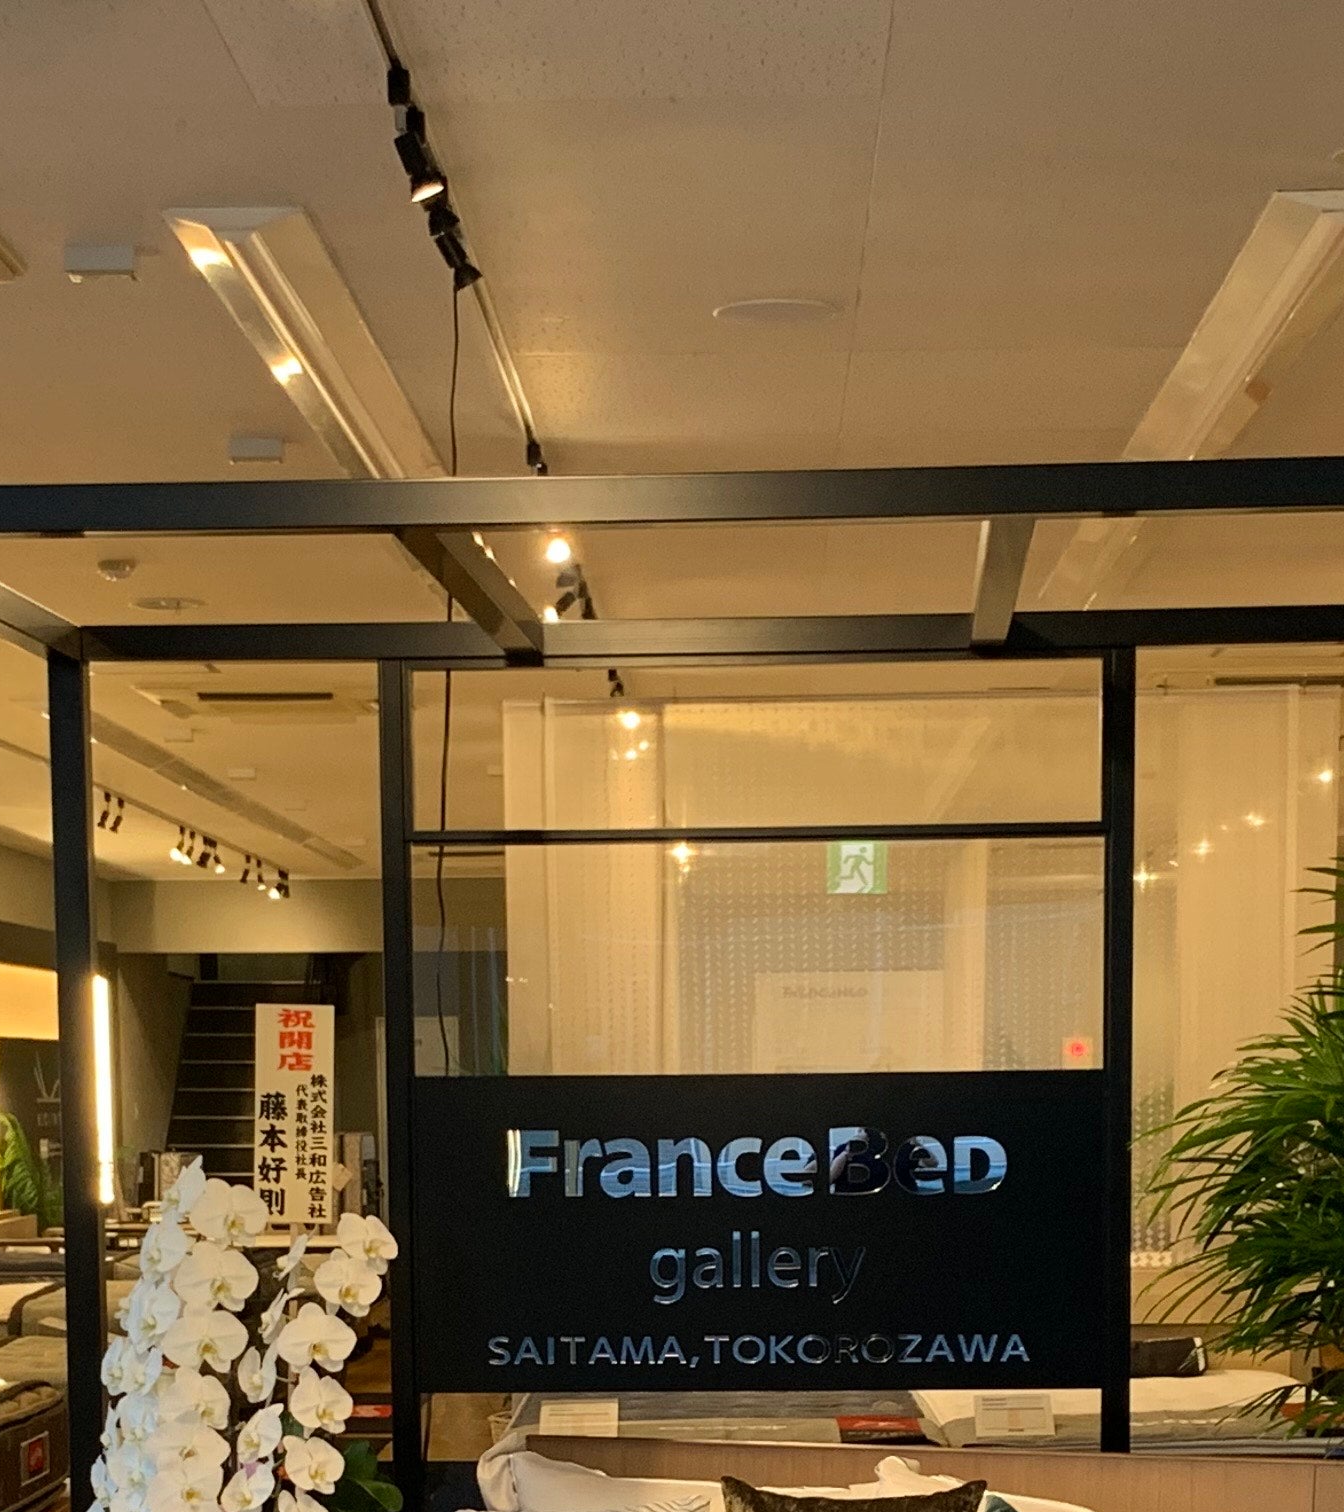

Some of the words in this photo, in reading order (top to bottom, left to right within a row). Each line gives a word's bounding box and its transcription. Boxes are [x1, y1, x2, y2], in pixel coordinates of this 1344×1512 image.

[277, 1008, 316, 1071] 祝開店
[258, 1091, 288, 1216] 藤本好則
[309, 1073, 328, 1218] 株式会社三和広告社
[649, 1231, 867, 1304] gallery
